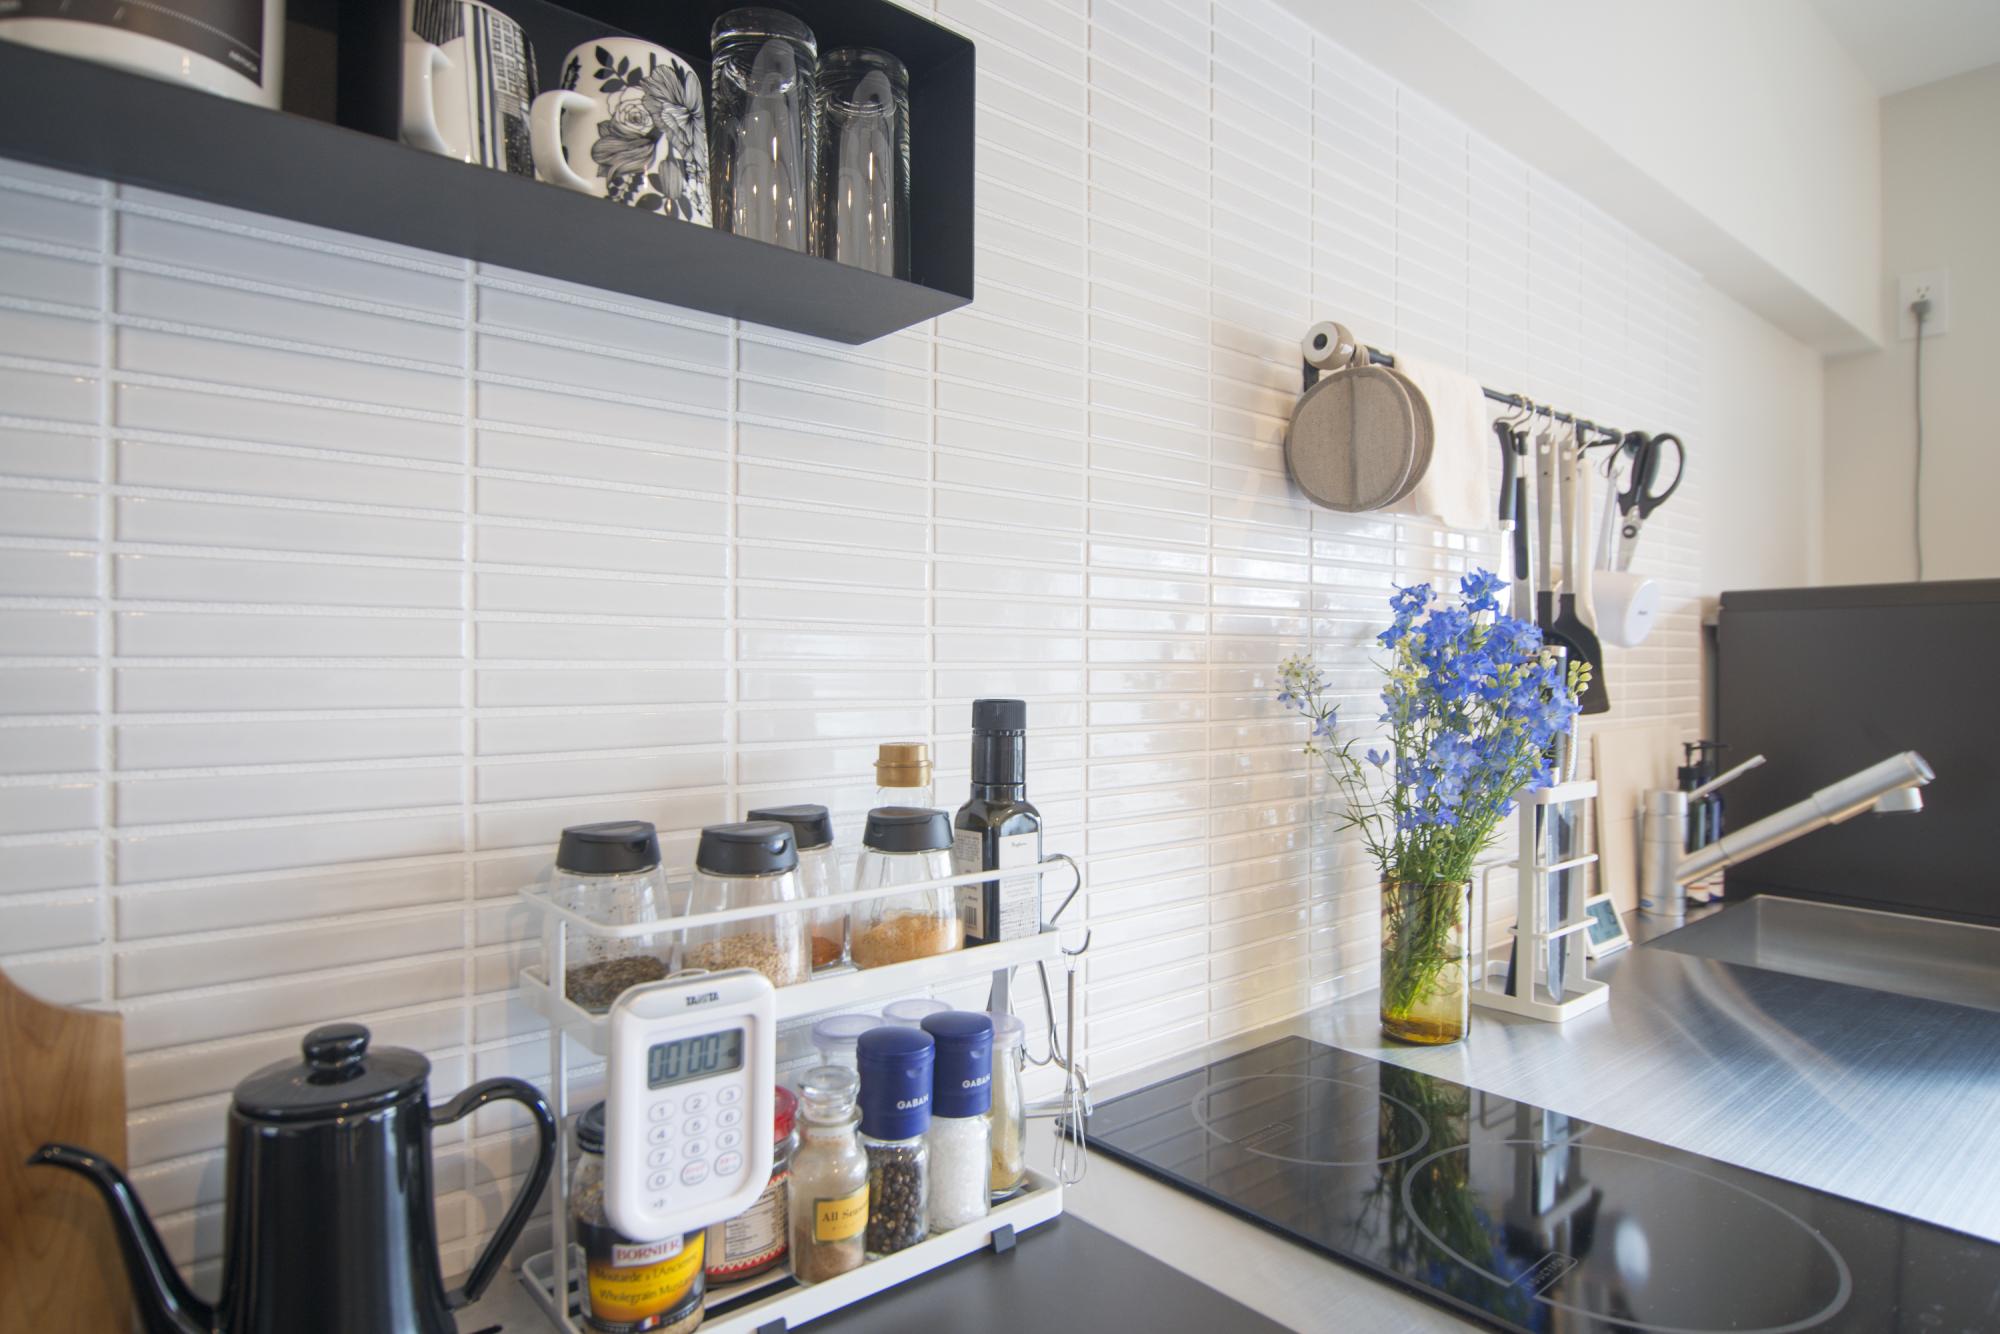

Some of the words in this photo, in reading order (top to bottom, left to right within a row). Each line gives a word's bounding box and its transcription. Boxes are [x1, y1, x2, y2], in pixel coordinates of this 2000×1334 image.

[962, 1073, 991, 1089] GABAN
[693, 1098, 702, 1110] 2
[896, 1093, 929, 1110] GABAN
[725, 1112, 734, 1122] 6
[724, 1135, 734, 1145] 9
[655, 1175, 666, 1186] 0
[821, 1210, 839, 1224] All
[617, 1241, 680, 1261] BORNIER
